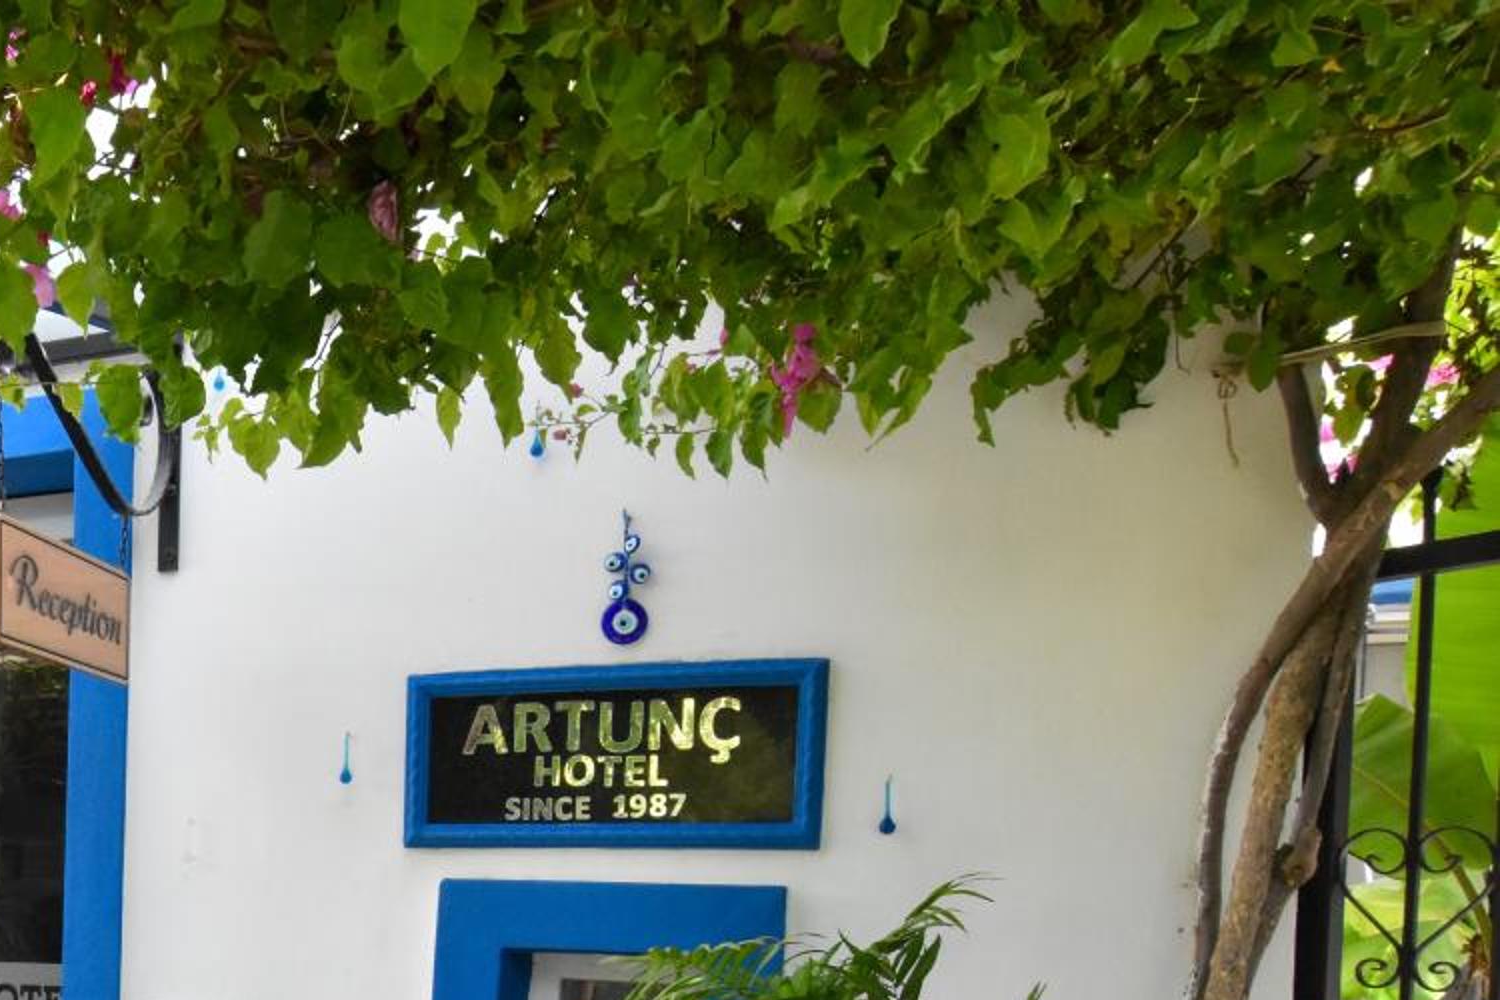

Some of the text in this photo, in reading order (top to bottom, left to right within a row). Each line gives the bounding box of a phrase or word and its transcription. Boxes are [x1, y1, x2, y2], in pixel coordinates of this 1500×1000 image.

[9, 555, 121, 645] Reception
[462, 697, 742, 764] ARTUNÇ
[533, 755, 668, 787] HOTEL
[504, 793, 687, 821] SINCE 1987
